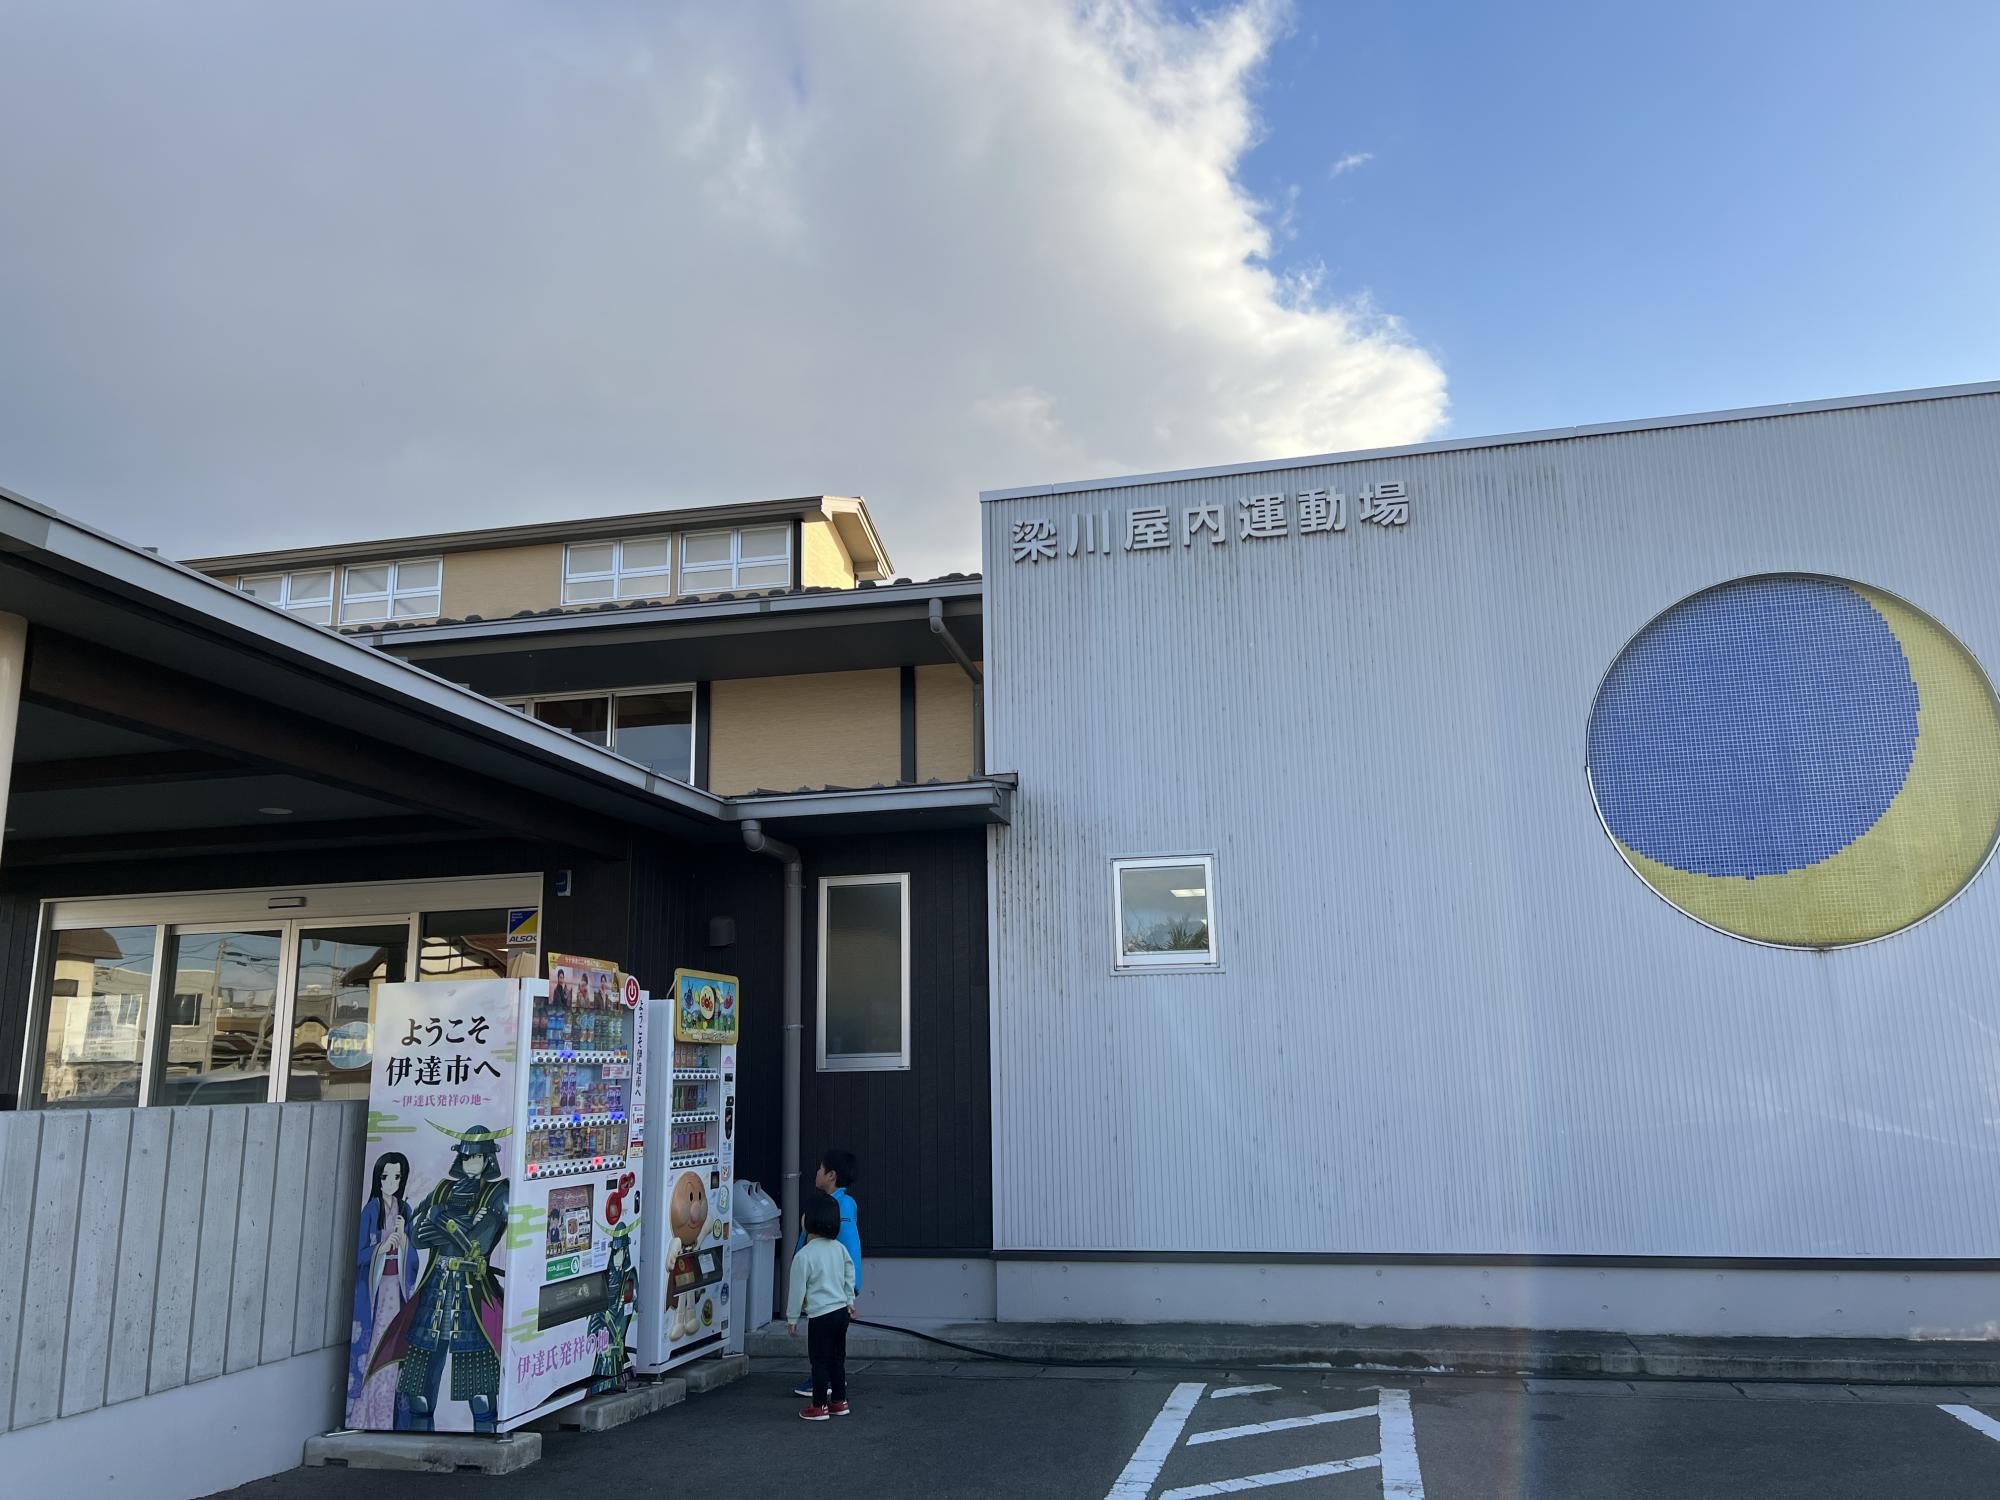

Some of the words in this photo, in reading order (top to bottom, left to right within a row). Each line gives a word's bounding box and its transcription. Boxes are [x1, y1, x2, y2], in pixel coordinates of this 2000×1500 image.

[1012, 481, 1410, 564] 梁川屋内運動場
[401, 1015, 490, 1047] ようこそ
[386, 1054, 501, 1087] 伊達市へ
[517, 1326, 610, 1384] 伊達氏発祥の地
